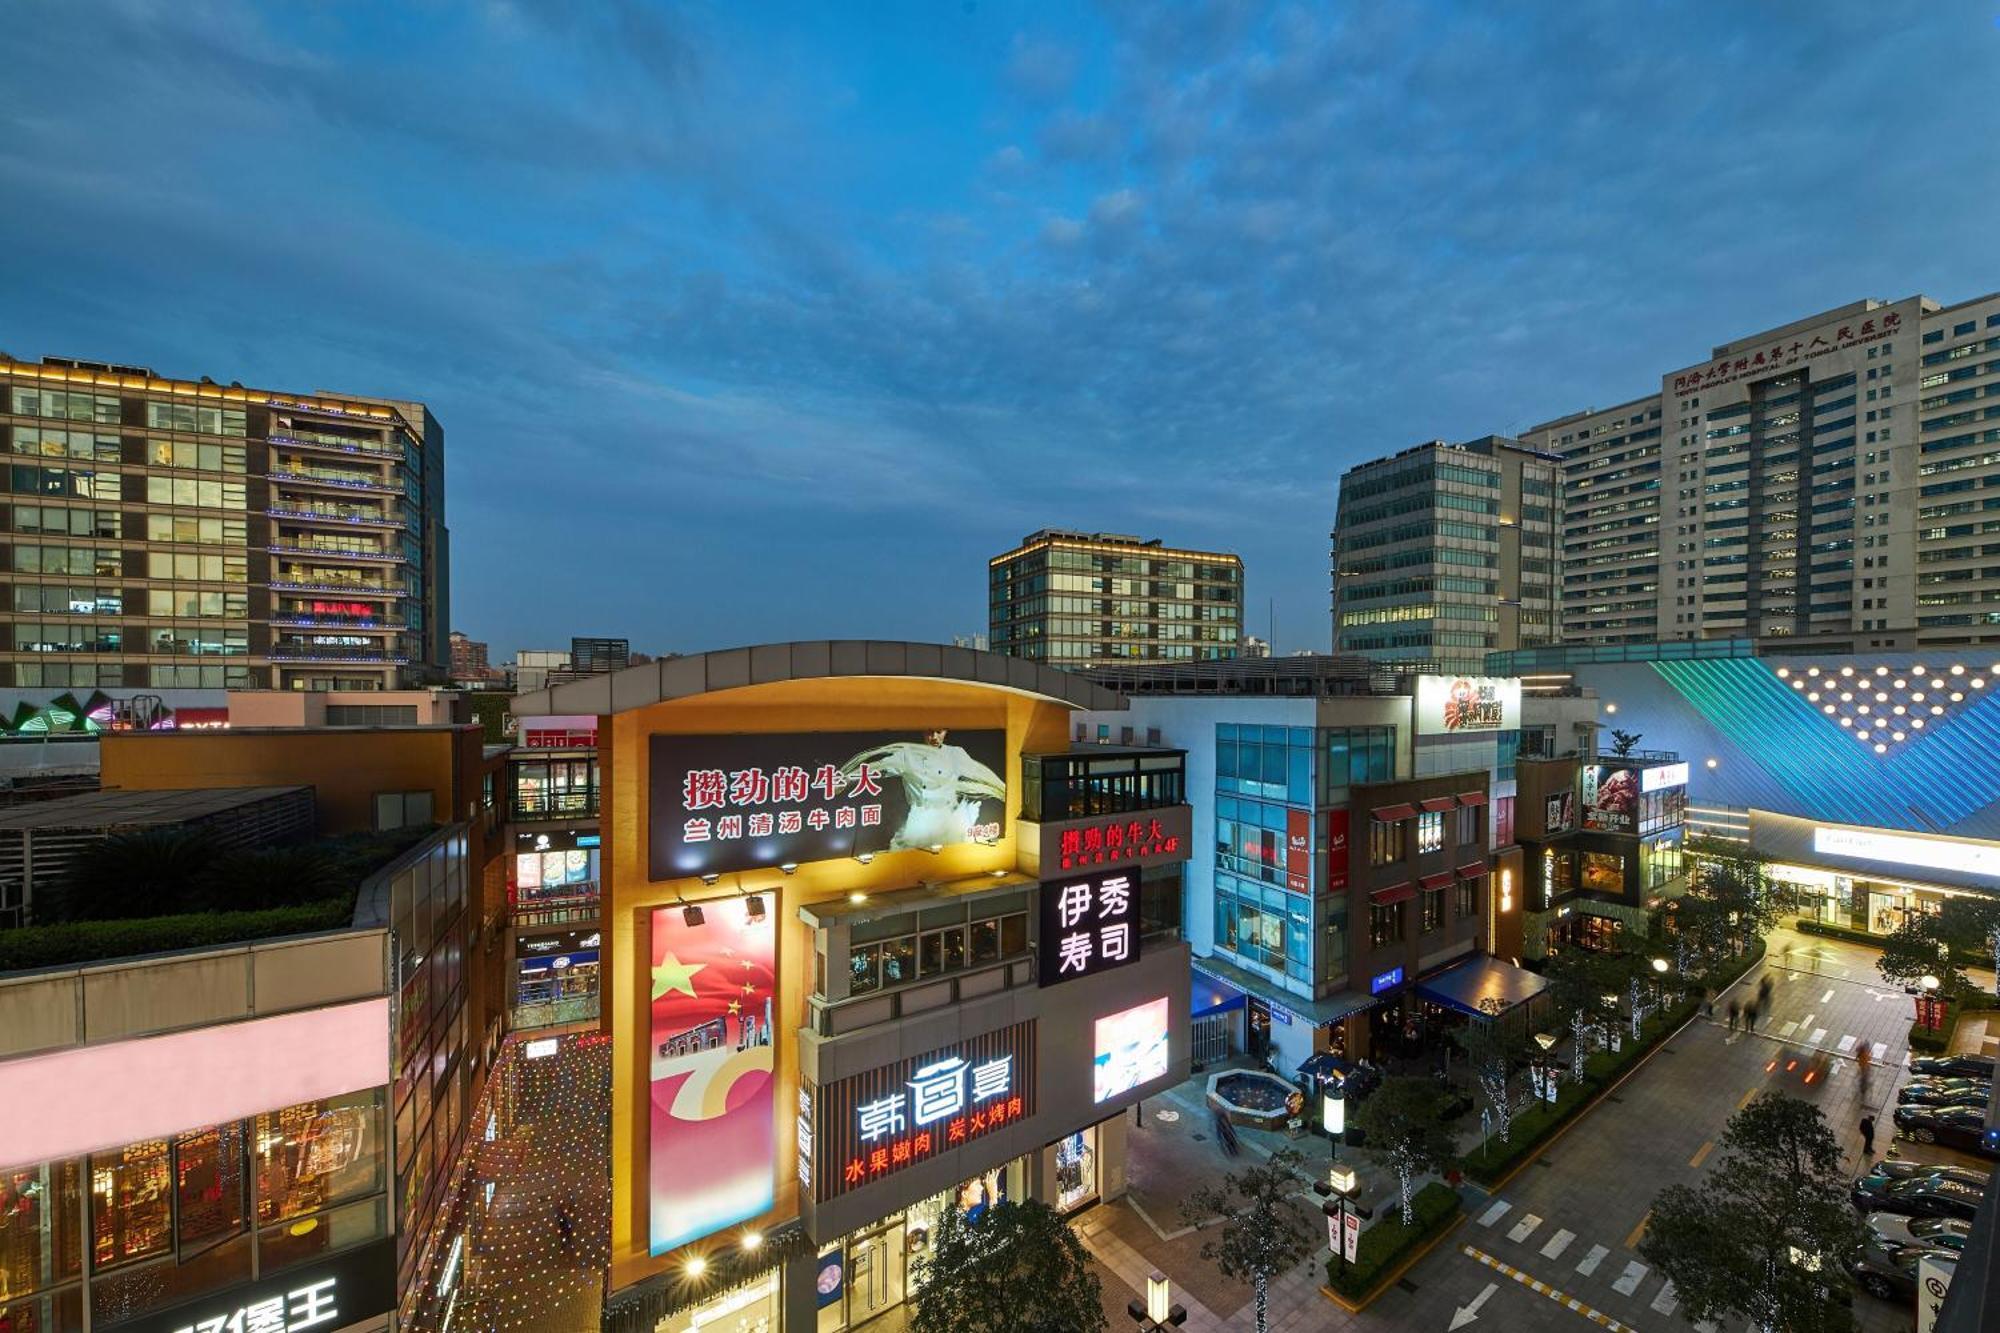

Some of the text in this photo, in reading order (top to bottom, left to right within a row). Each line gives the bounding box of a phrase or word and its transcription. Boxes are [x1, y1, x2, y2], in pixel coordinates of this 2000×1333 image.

[1739, 363, 1780, 379] HOSPITAL
[1786, 356, 1799, 365] OF
[1804, 345, 1838, 360] TONGJI
[1842, 328, 1900, 350] UNIVERSITY
[684, 763, 883, 809] 攒劲的牛大
[684, 805, 882, 842] 兰州清汤牛肉面
[1058, 877, 1130, 928] 伊秀
[1059, 922, 1129, 973] 寿司
[845, 1098, 1022, 1182] 水果嫩肉 炭火烤肉
